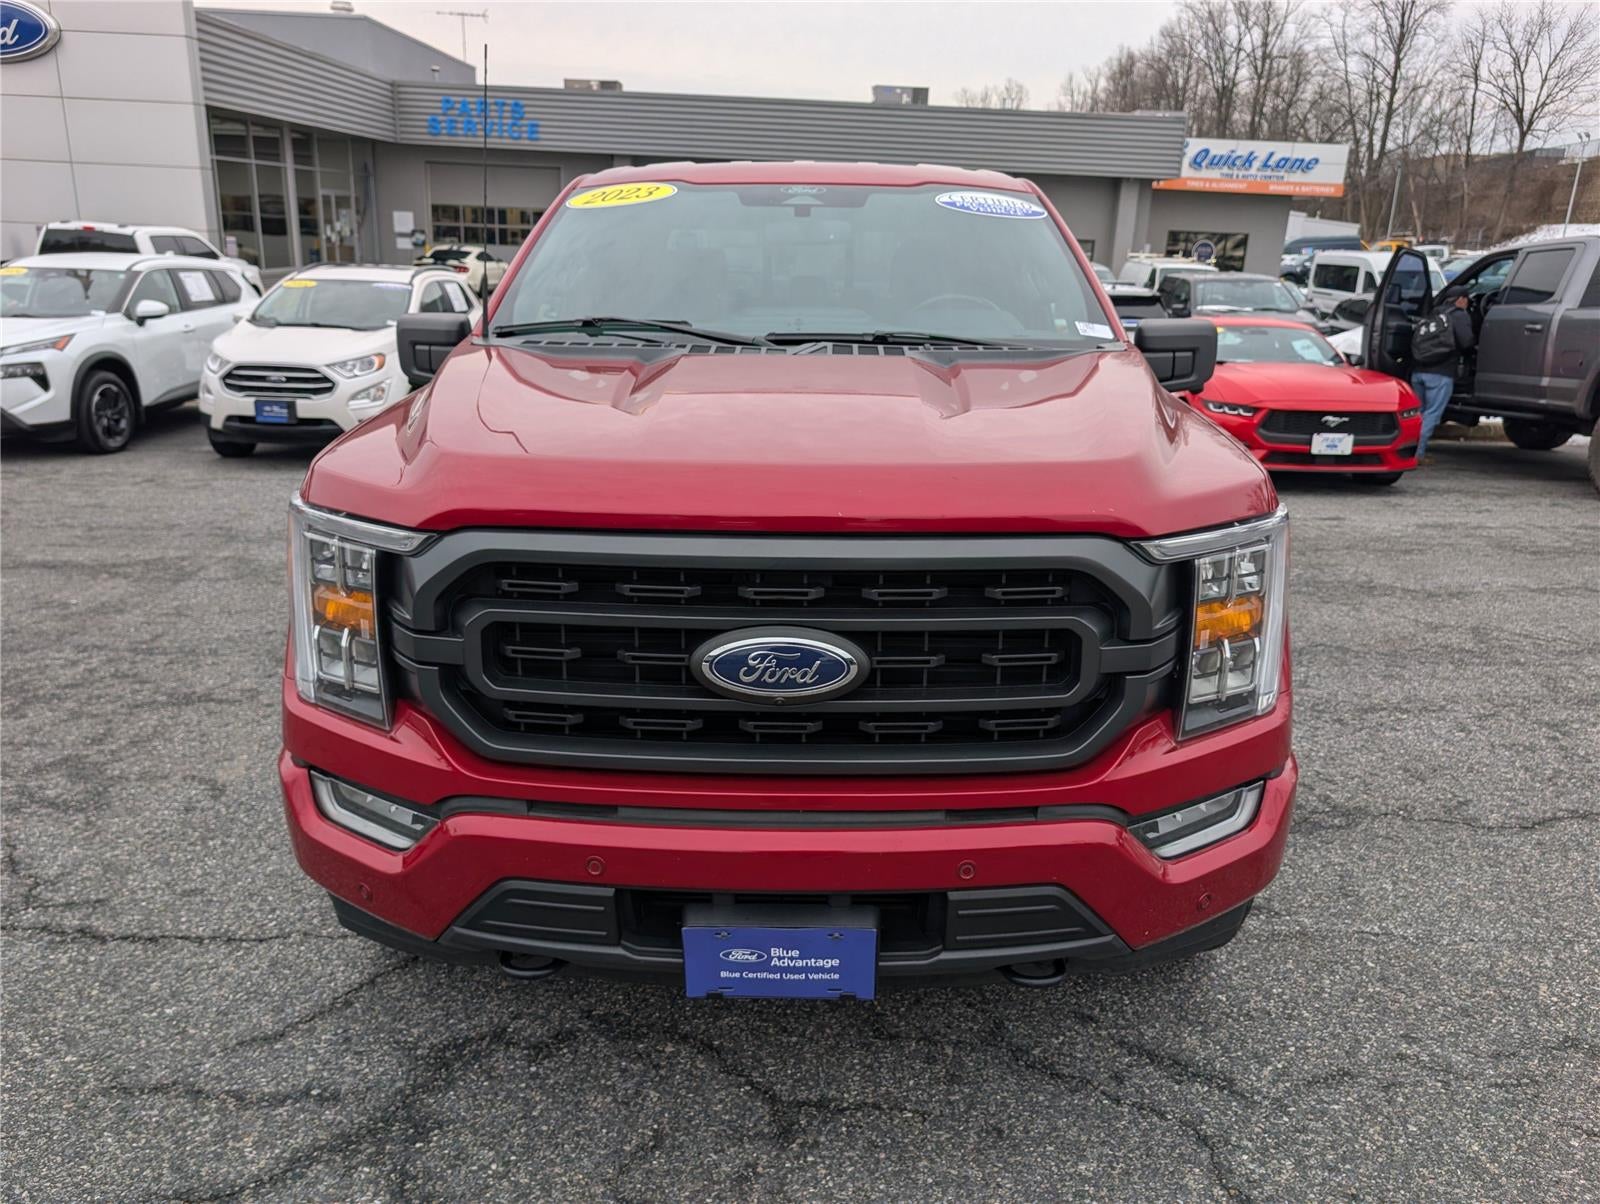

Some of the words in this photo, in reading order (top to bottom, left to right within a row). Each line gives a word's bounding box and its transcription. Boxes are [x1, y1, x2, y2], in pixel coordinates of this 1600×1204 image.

[441, 97, 525, 120] PARTS
[427, 115, 540, 141] SERVICE
[1189, 148, 1258, 172] Quick
[1258, 151, 1320, 173] Lane
[582, 186, 661, 205] 2023
[738, 650, 821, 684] Ford
[728, 950, 759, 961] Ford
[770, 948, 800, 958] Blue
[770, 957, 840, 968] Advantage
[720, 970, 741, 978] Blue
[742, 971, 781, 980] Certified
[782, 972, 806, 980] Used
[808, 972, 840, 980] Vehicle
